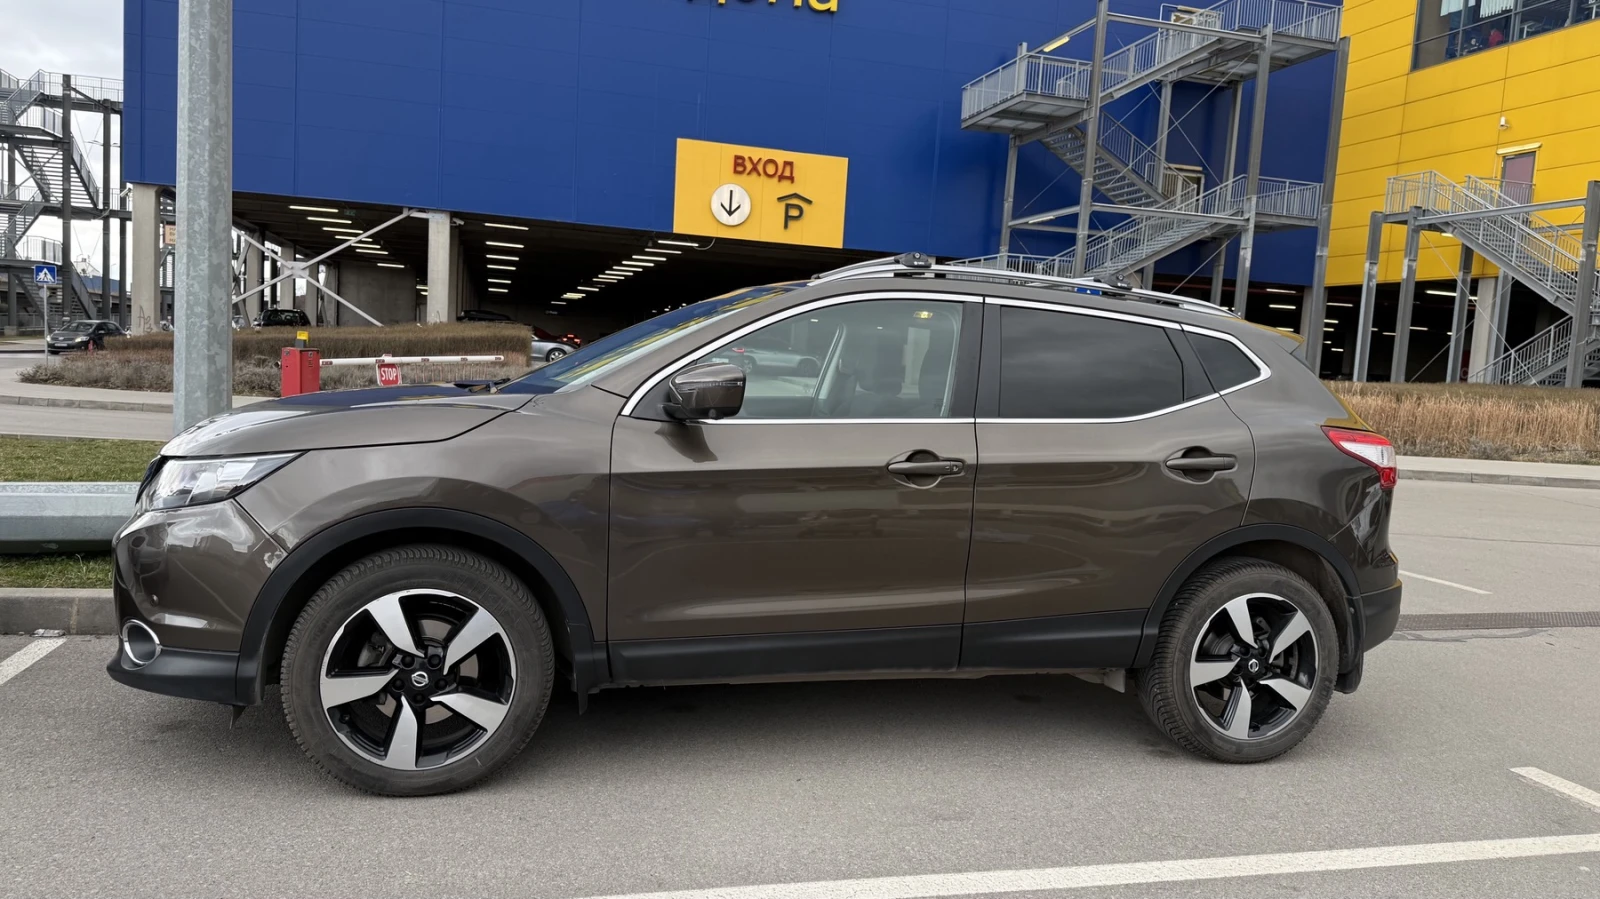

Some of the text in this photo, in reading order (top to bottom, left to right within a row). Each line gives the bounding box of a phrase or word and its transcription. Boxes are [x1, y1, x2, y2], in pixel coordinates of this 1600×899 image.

[733, 154, 795, 184] ВХОД
[783, 203, 804, 230] P
[380, 367, 397, 381] STOP
